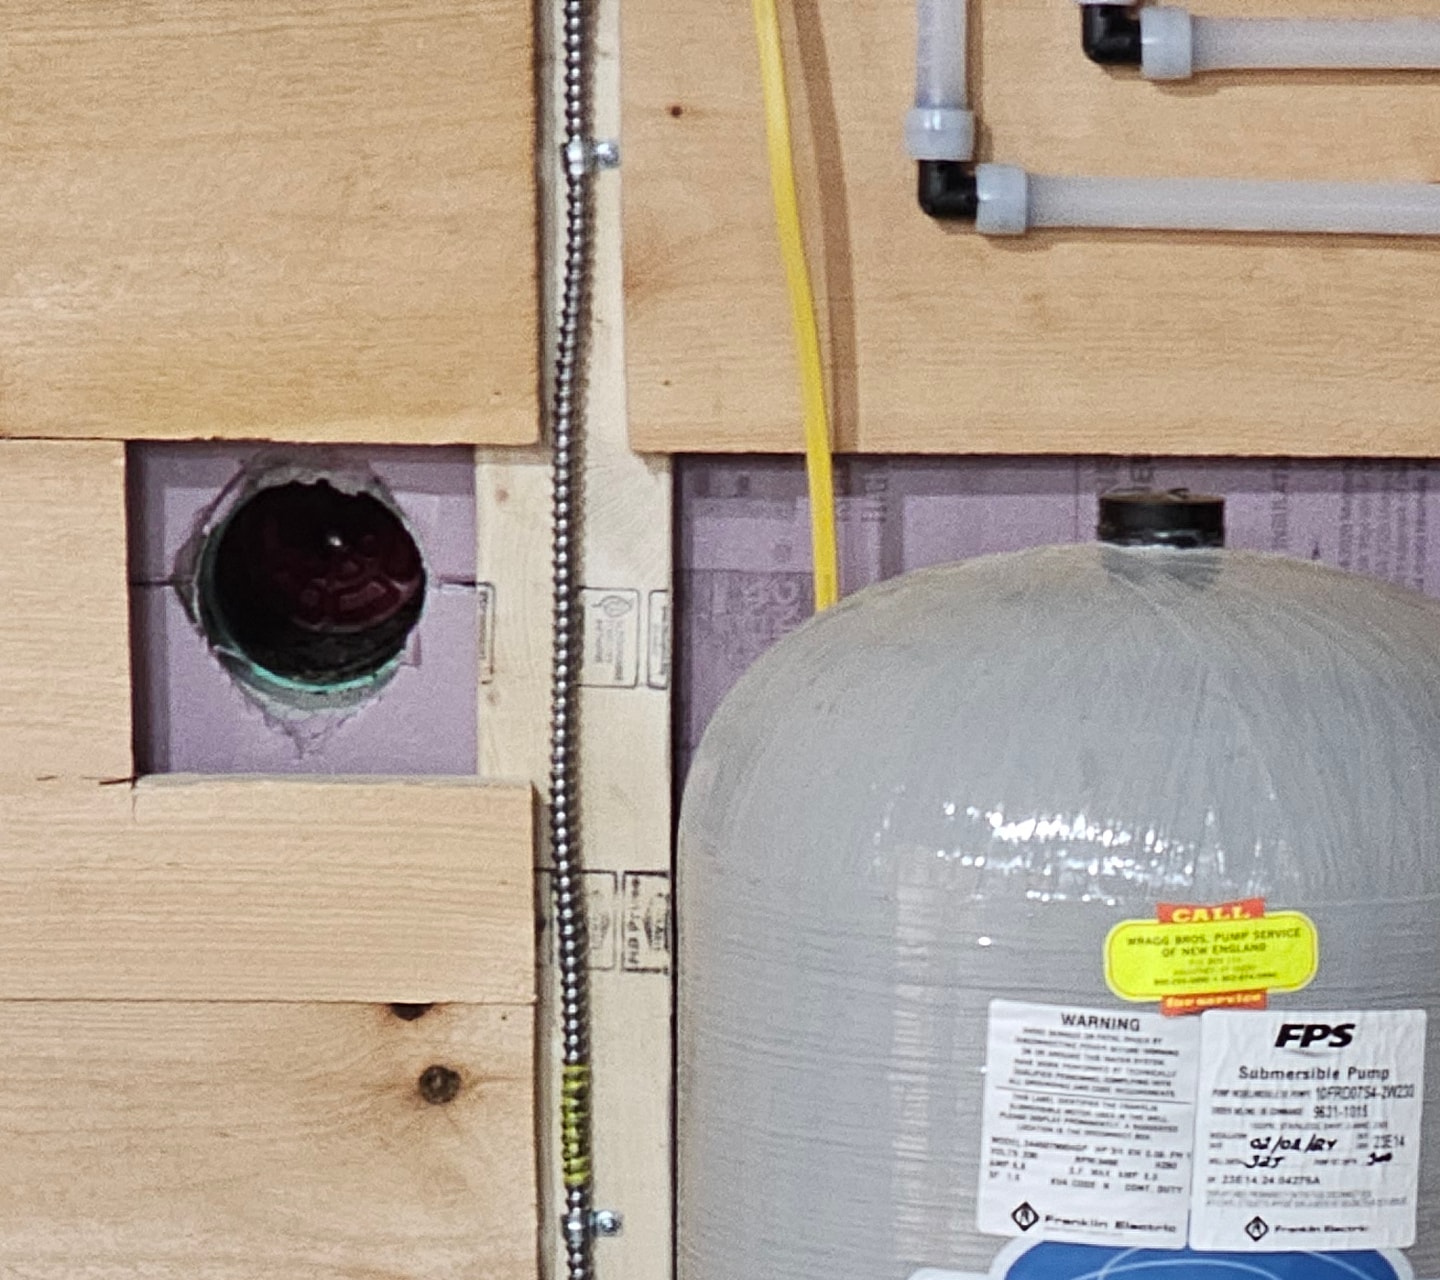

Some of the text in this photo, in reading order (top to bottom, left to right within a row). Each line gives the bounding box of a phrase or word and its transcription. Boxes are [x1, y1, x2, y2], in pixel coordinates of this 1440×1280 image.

[1172, 906, 1250, 923] CALL
[1214, 931, 1249, 942] PUMP
[1253, 927, 1301, 940] SERVICE
[1161, 943, 1267, 958] OF NEW ENGLAND
[1061, 1013, 1141, 1032] WARNING
[1274, 1023, 1356, 1048] FPS
[1238, 1065, 1390, 1082] Submersible Pump
[1045, 1214, 1108, 1229] Franklin
[1115, 1220, 1177, 1233] Electric
[1274, 1224, 1320, 1233] Franklin
